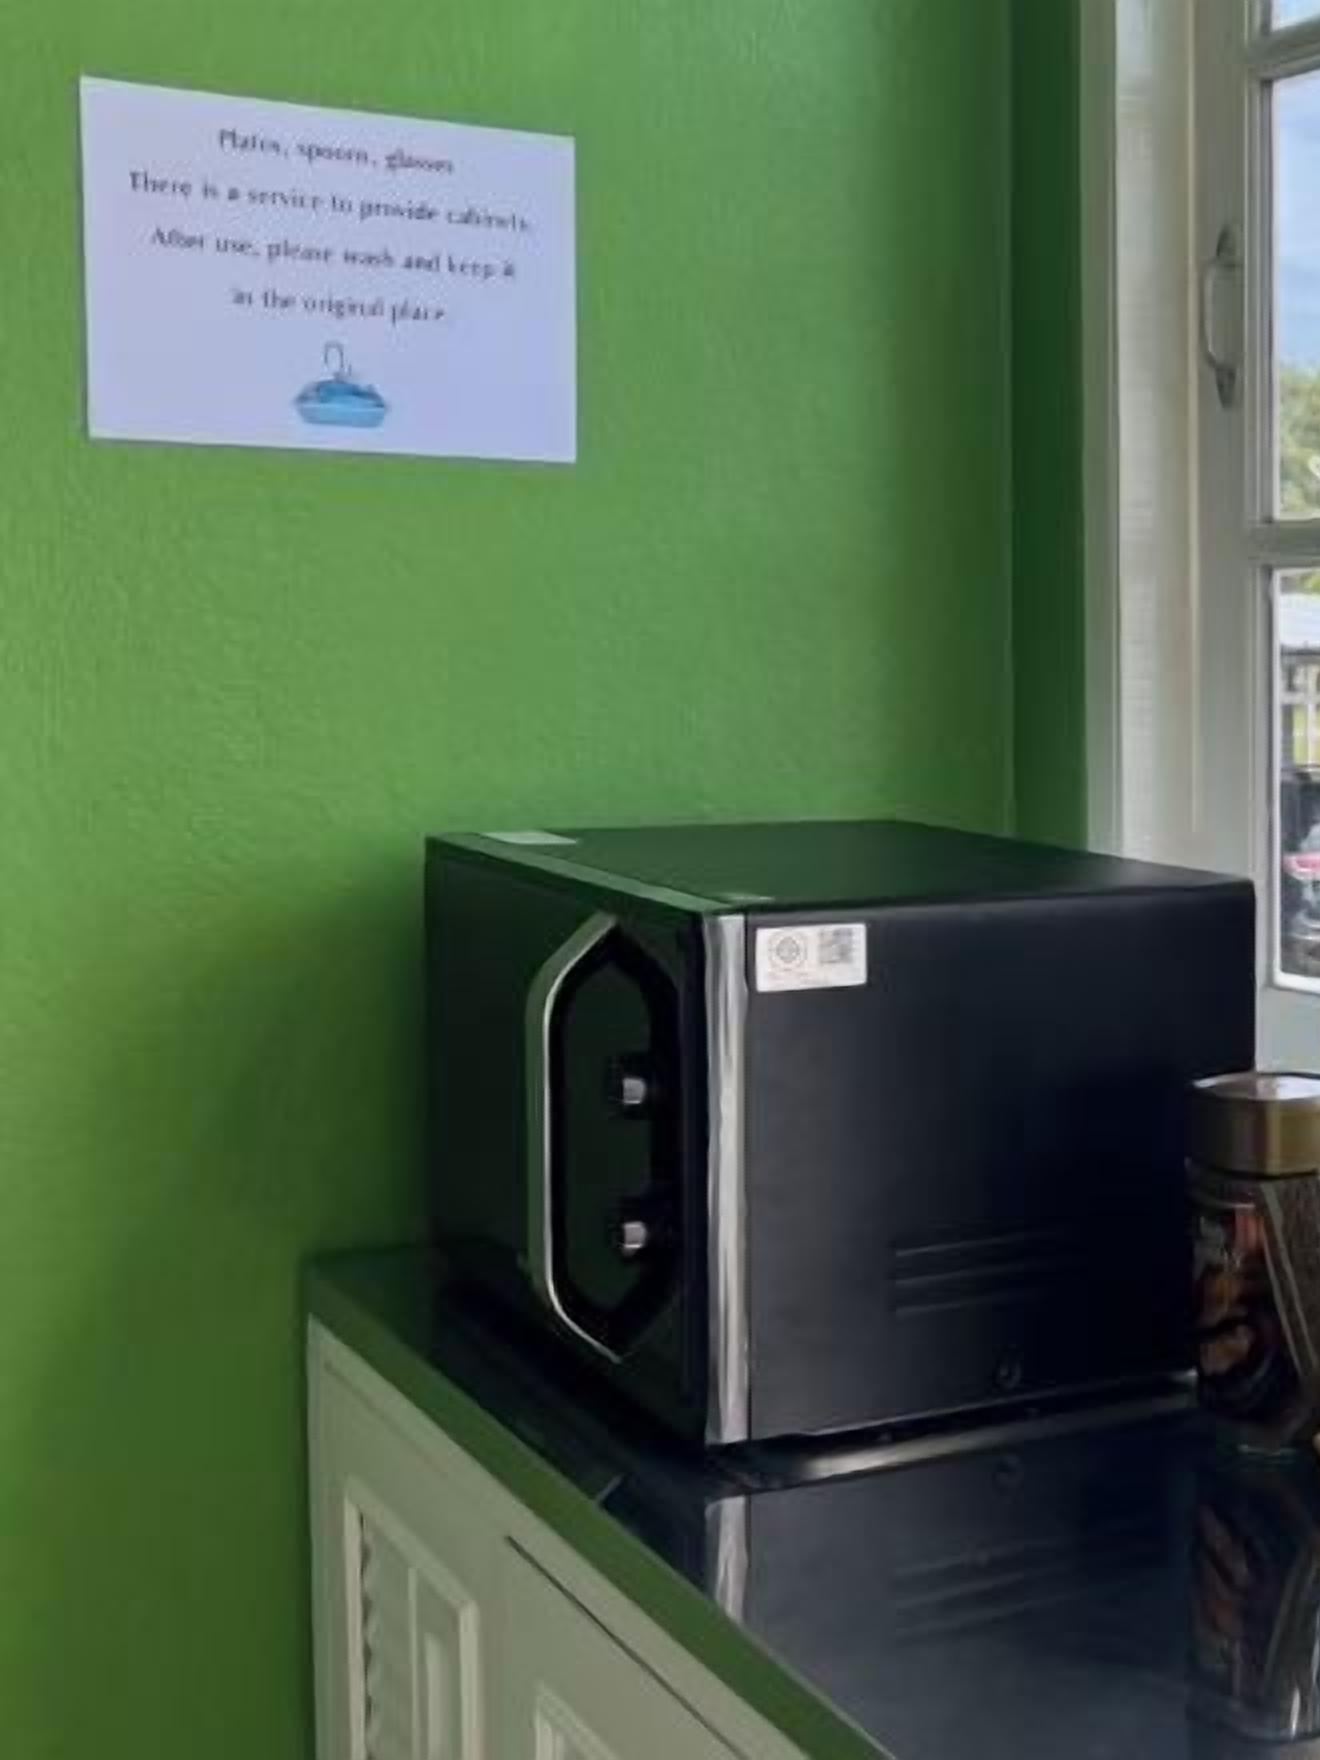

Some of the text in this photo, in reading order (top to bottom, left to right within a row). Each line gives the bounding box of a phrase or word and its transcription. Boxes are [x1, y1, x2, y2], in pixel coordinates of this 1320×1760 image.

[130, 170, 192, 198] There
[202, 178, 219, 199] is
[228, 187, 240, 201] a
[248, 188, 322, 210] service
[331, 195, 352, 213] to
[359, 199, 438, 223] provide
[152, 228, 204, 249] After
[266, 239, 334, 265] please
[343, 247, 394, 268] wash
[403, 254, 441, 272] and
[448, 256, 499, 281] keep
[231, 288, 253, 306] in
[264, 289, 297, 309] the
[302, 296, 385, 320] original
